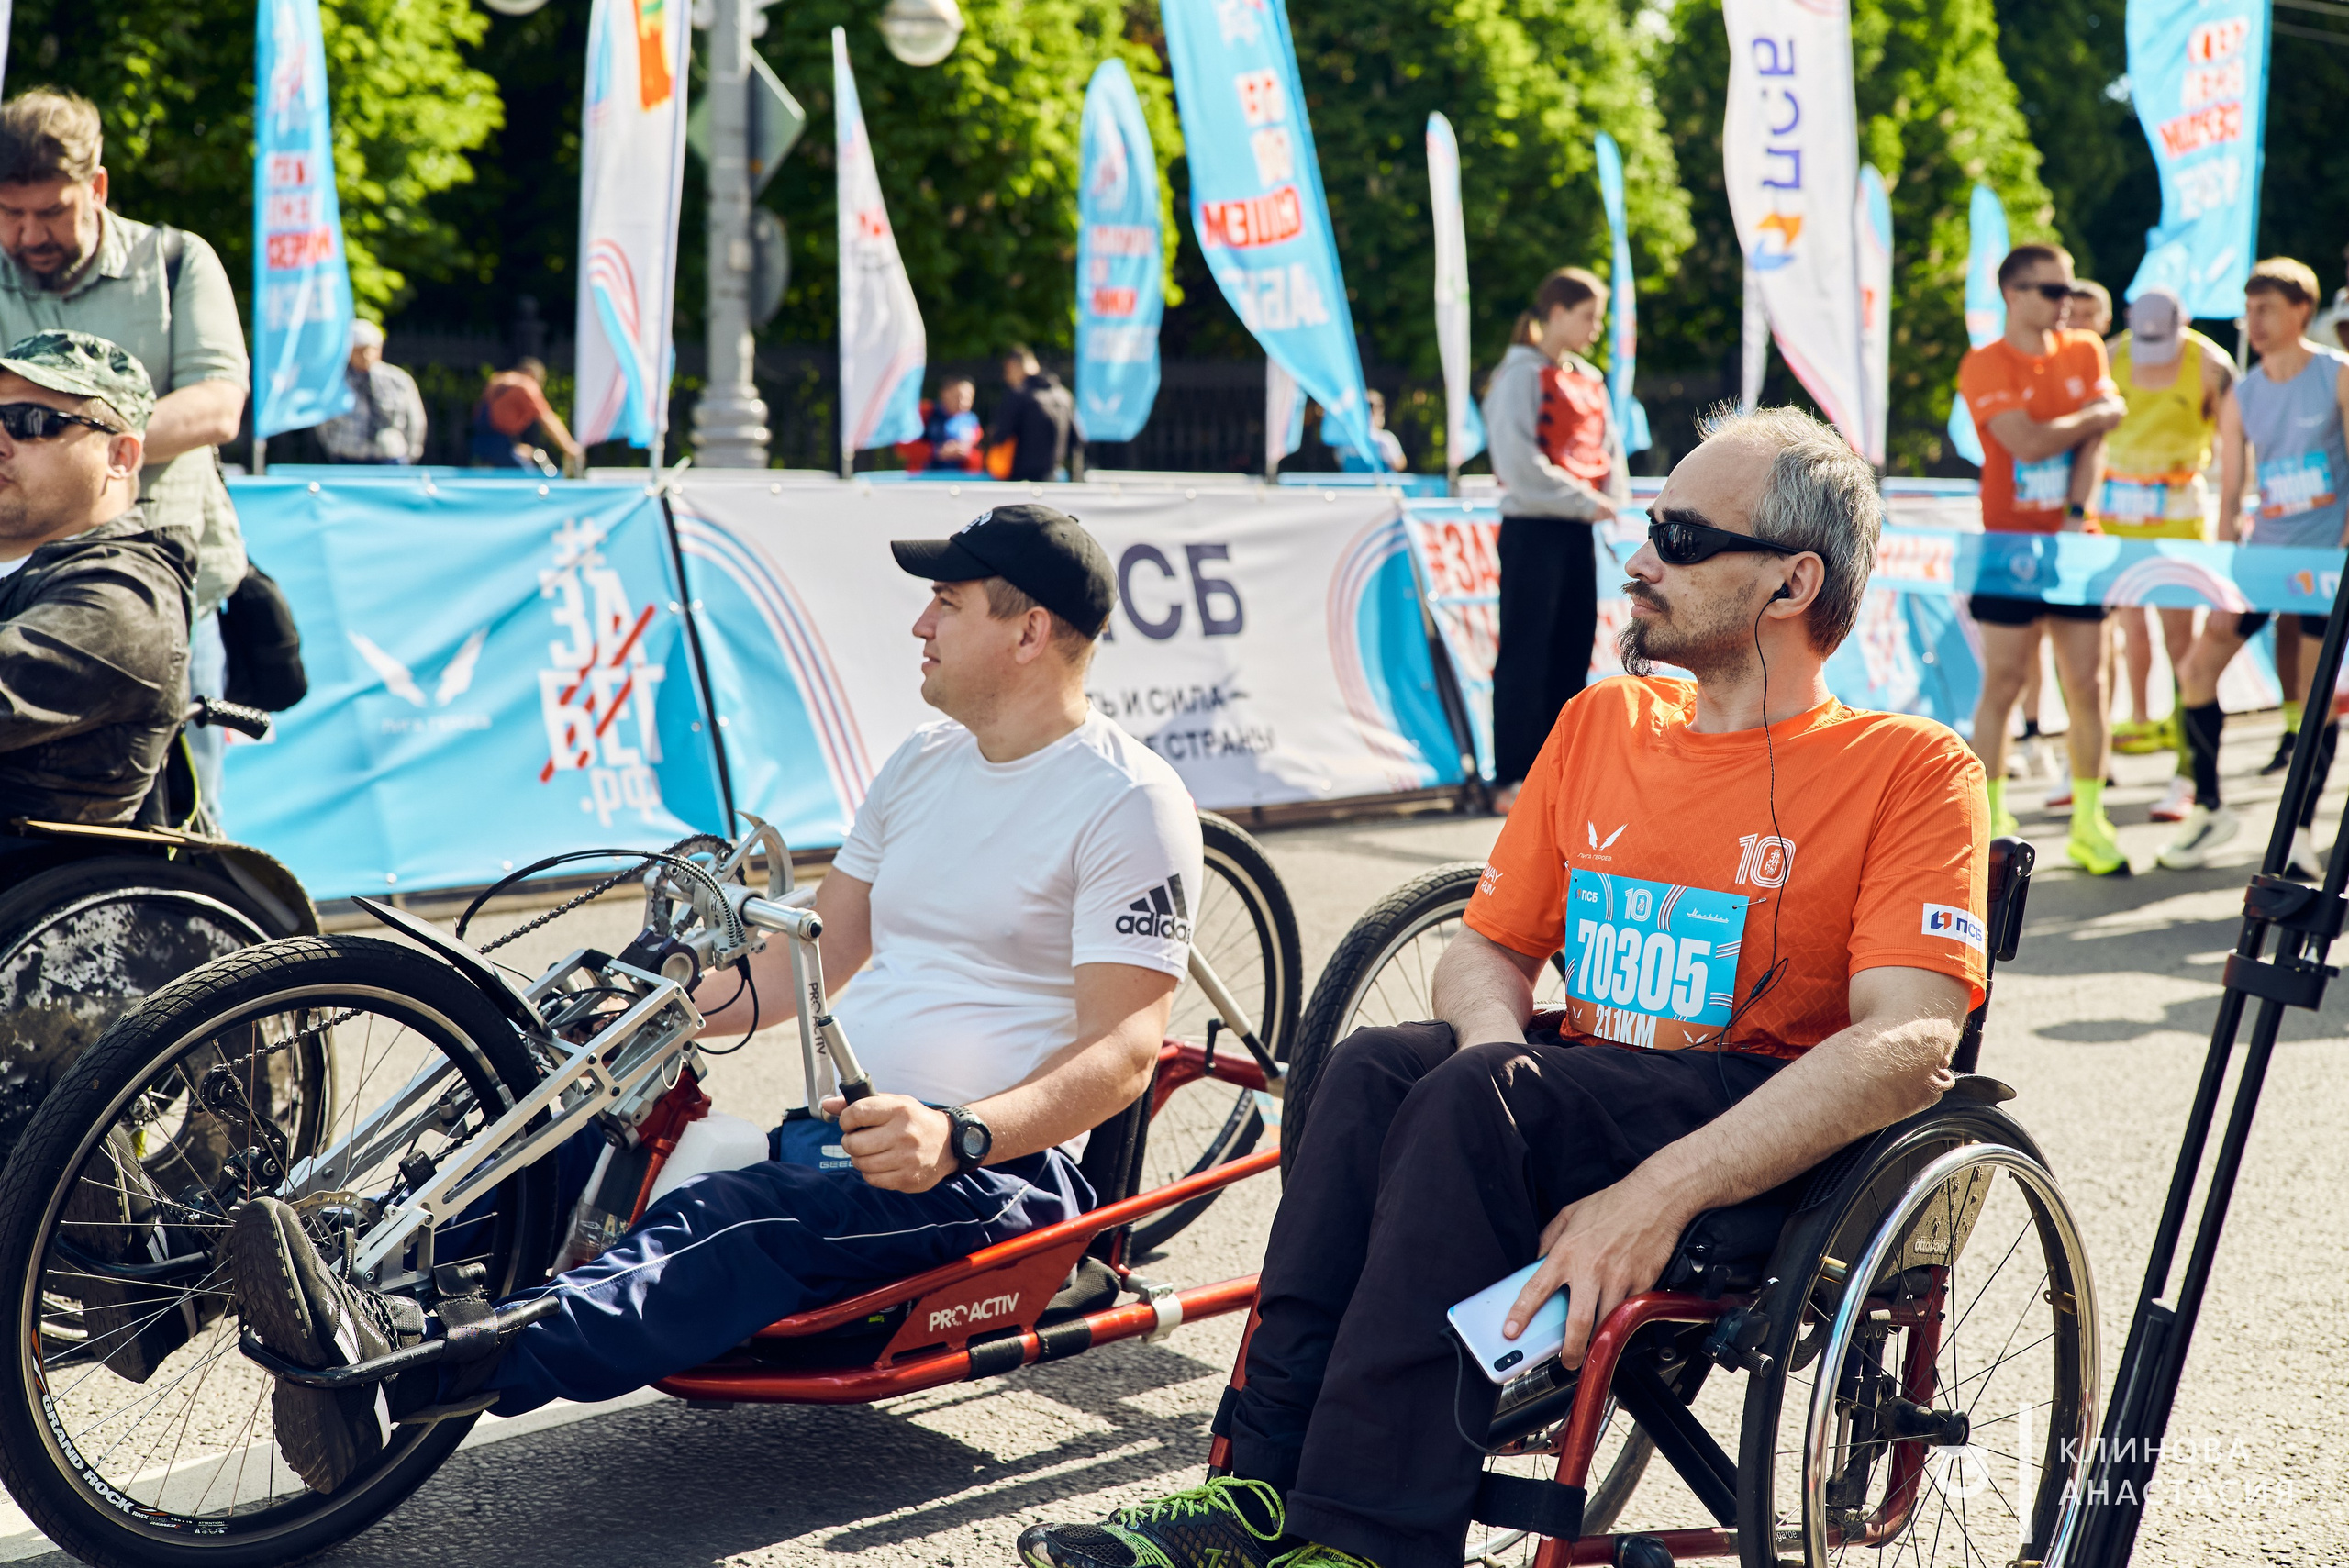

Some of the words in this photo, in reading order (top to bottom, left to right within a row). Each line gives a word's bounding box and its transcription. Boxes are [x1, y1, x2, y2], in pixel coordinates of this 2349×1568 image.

[538, 569, 648, 671] ЗА
[1102, 543, 1244, 641] СБ
[537, 662, 667, 773] БЕГ
[1581, 889, 1598, 903] ПСБ
[1955, 917, 1982, 942] ПСБ
[1577, 918, 1711, 1018] 70305
[42, 1394, 85, 1470] GRAND
[83, 1469, 135, 1514] ROCK
